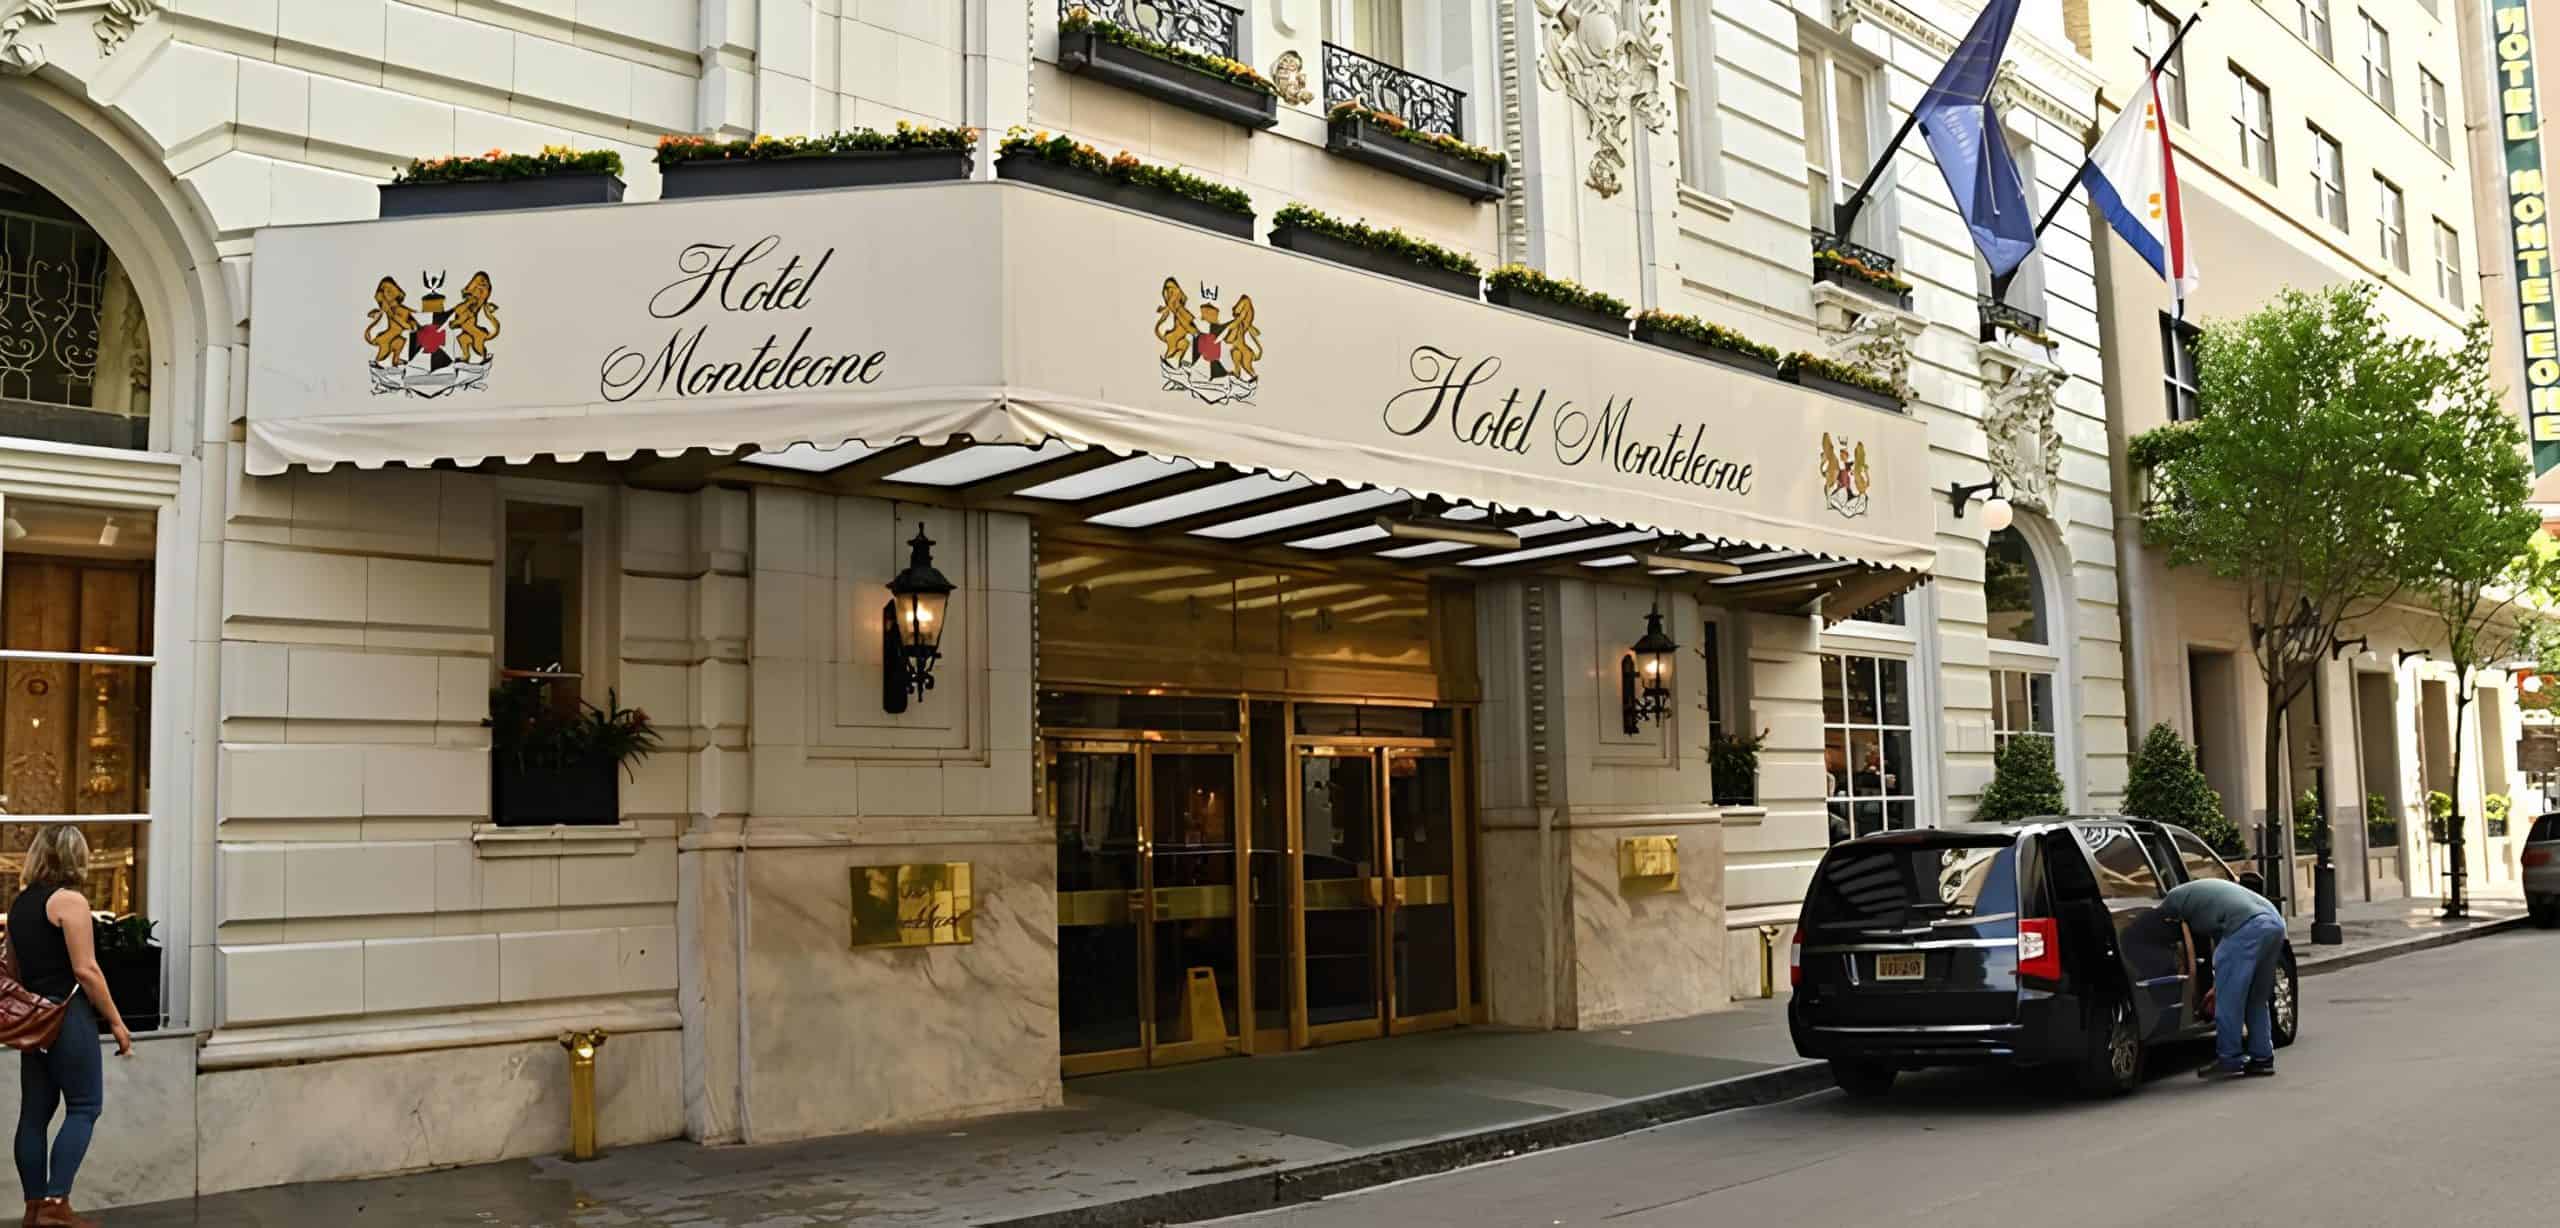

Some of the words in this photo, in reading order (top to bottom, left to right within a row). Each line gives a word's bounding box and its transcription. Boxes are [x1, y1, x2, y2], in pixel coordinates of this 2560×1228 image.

[2495, 6, 2538, 140] HOTEL
[648, 233, 835, 319] Hotel
[2509, 168, 2560, 441] MONTELEONE
[600, 324, 887, 402] Monteleone
[1383, 345, 1547, 455] Hotel
[1553, 394, 1753, 496] Monteleone
